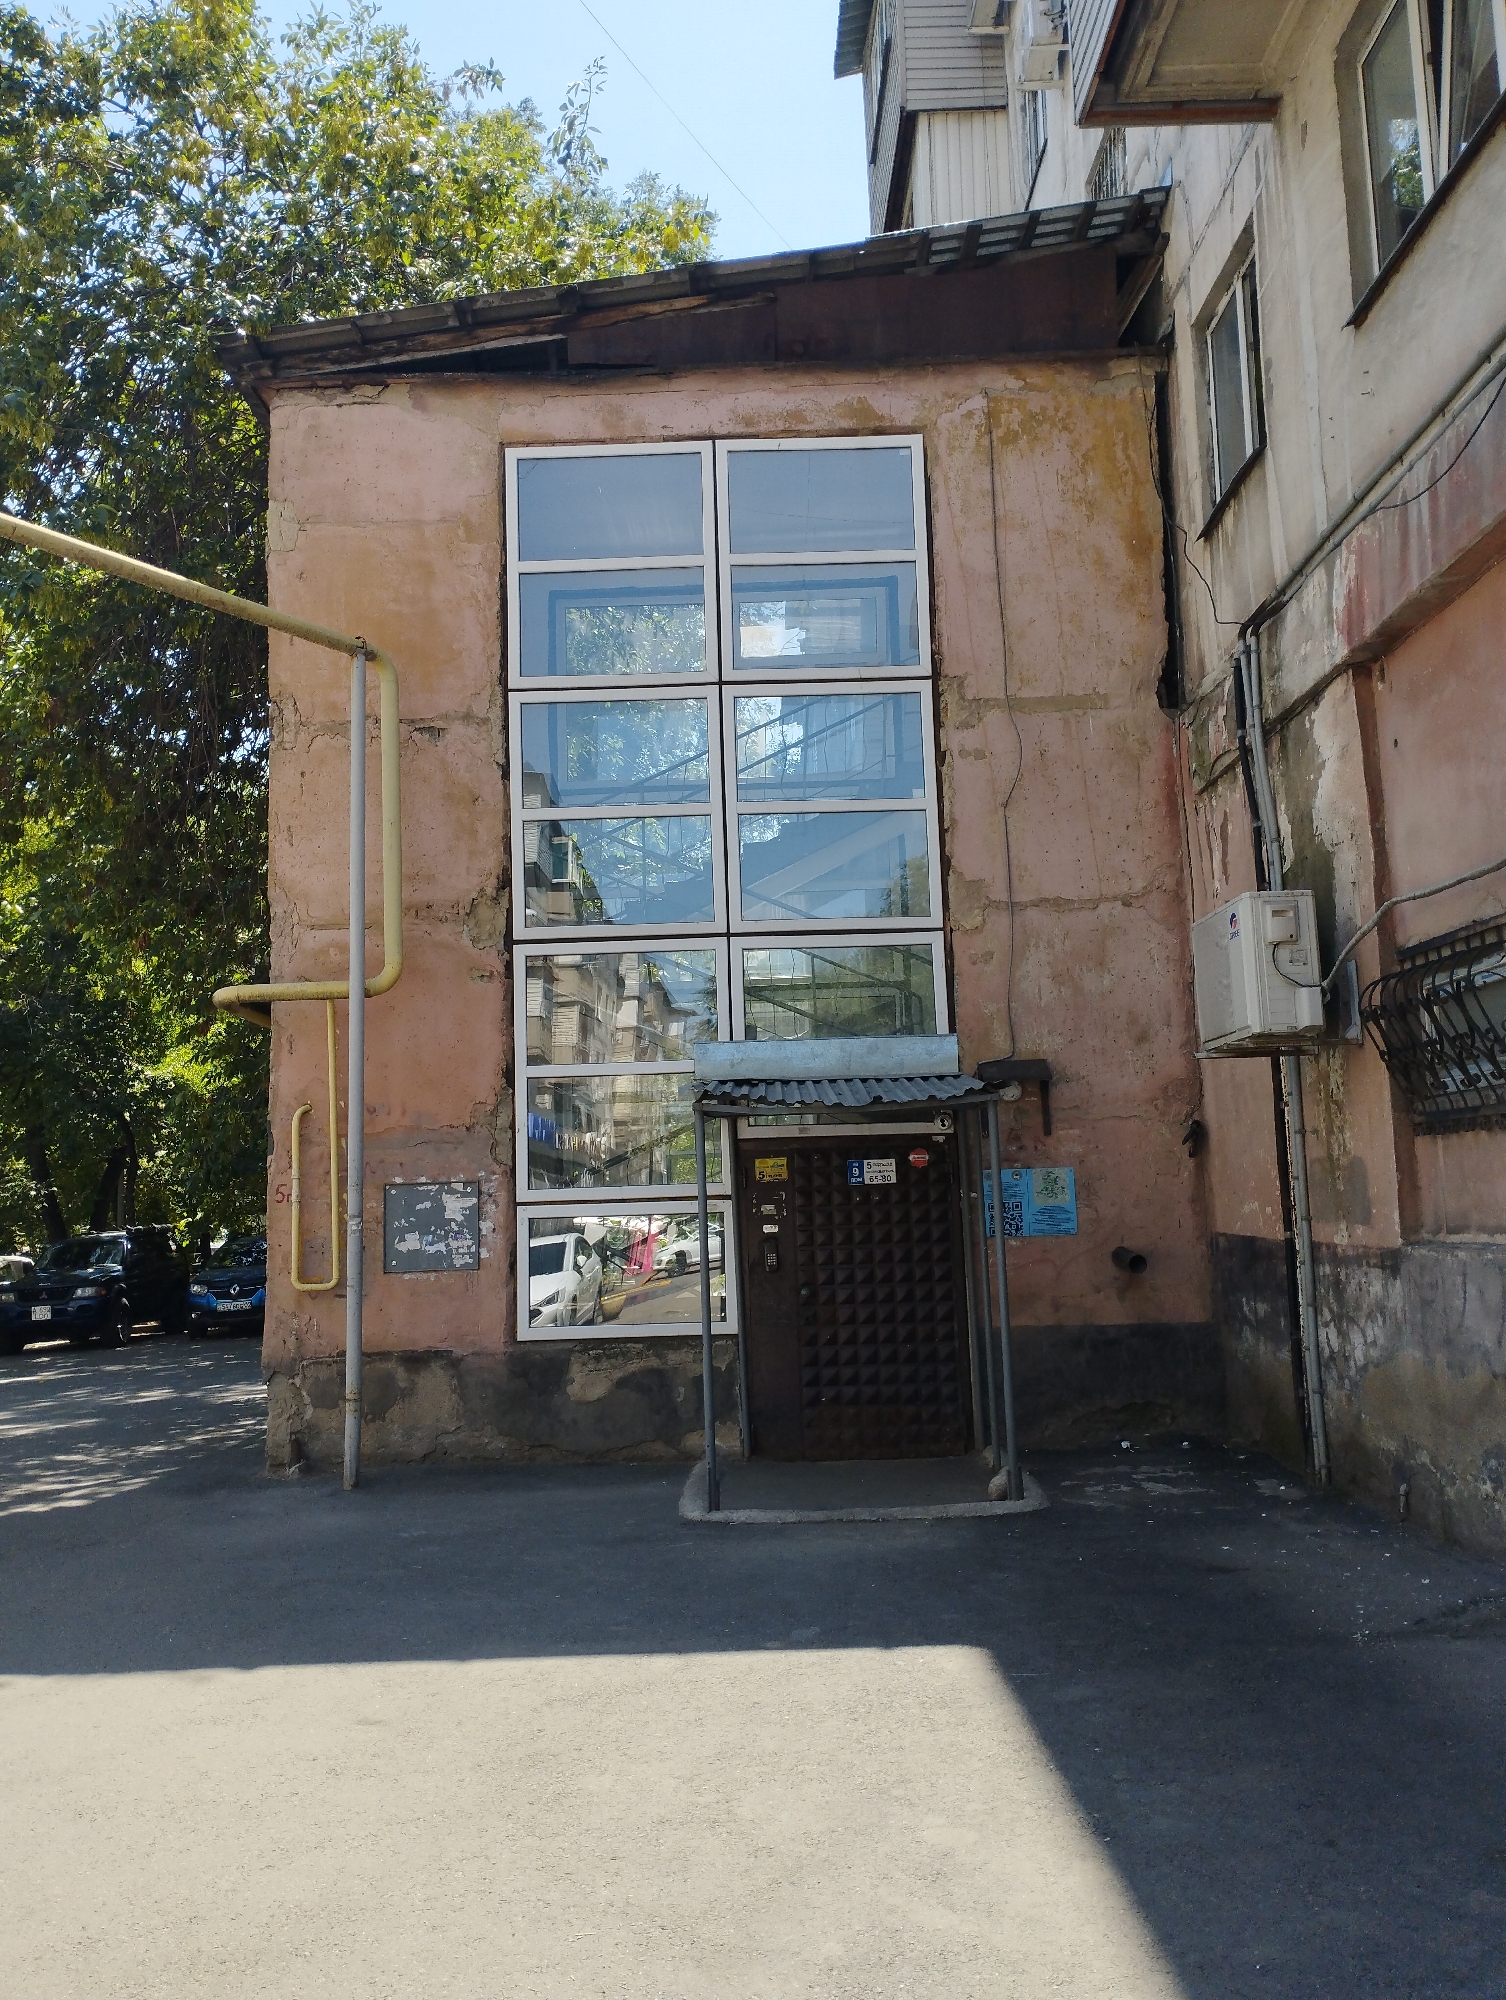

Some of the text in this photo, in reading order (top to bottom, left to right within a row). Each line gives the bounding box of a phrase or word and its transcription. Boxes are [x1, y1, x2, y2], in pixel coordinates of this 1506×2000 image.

[866, 1161, 872, 1169] 5
[758, 1171, 765, 1180] 5
[852, 1167, 859, 1176] 9
